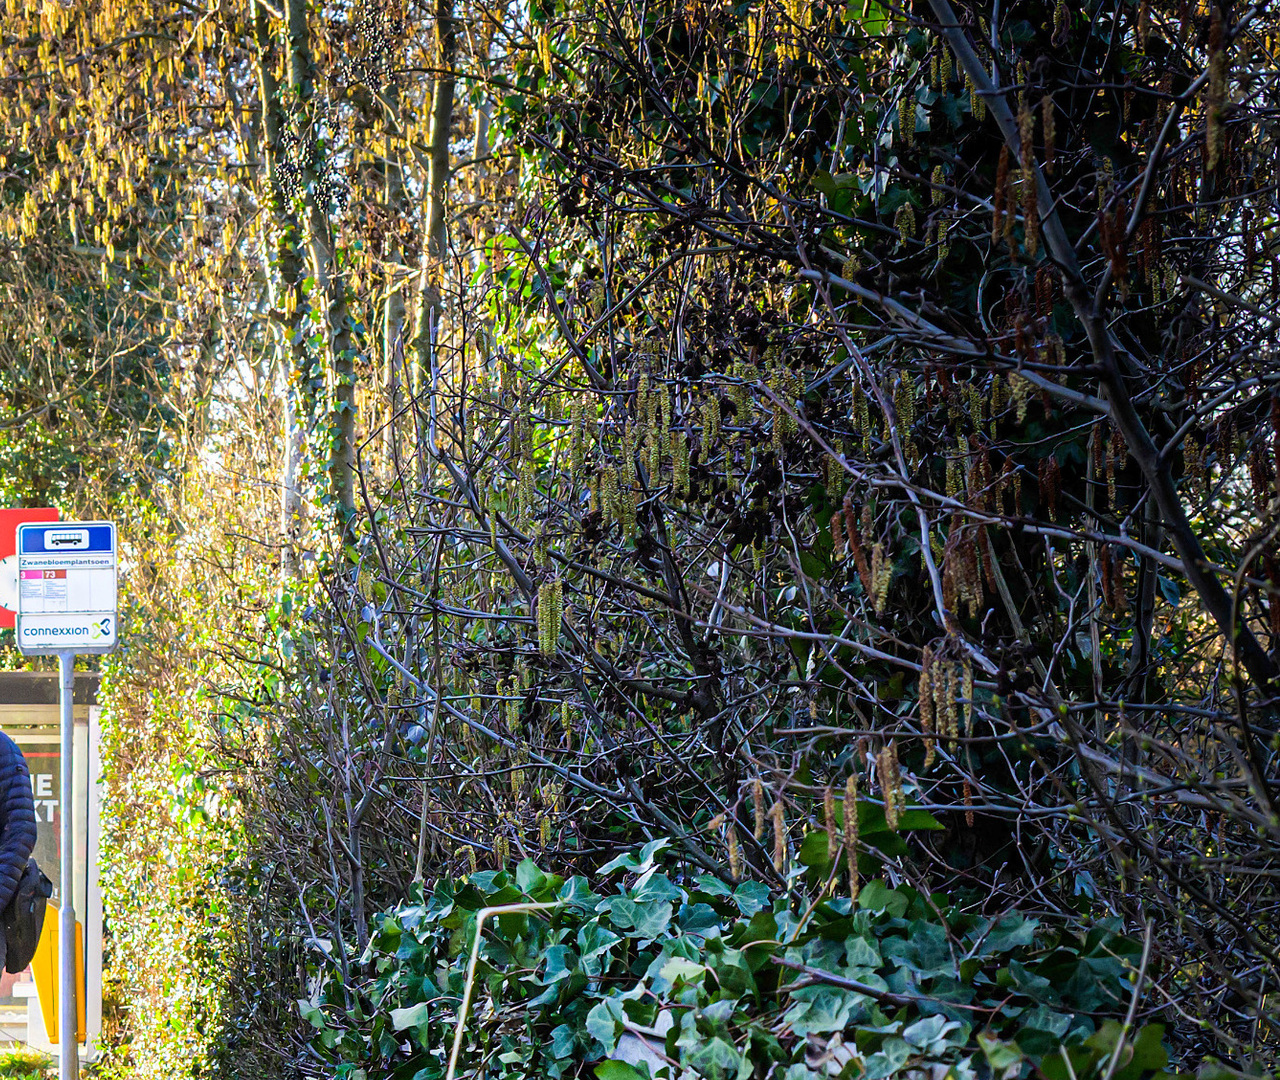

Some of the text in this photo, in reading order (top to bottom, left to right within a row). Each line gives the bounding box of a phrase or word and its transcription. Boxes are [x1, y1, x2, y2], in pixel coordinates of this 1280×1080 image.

[21, 559, 110, 567] Zwanebloemplantsoen
[44, 570, 56, 578] 73
[23, 627, 89, 637] connexxion
